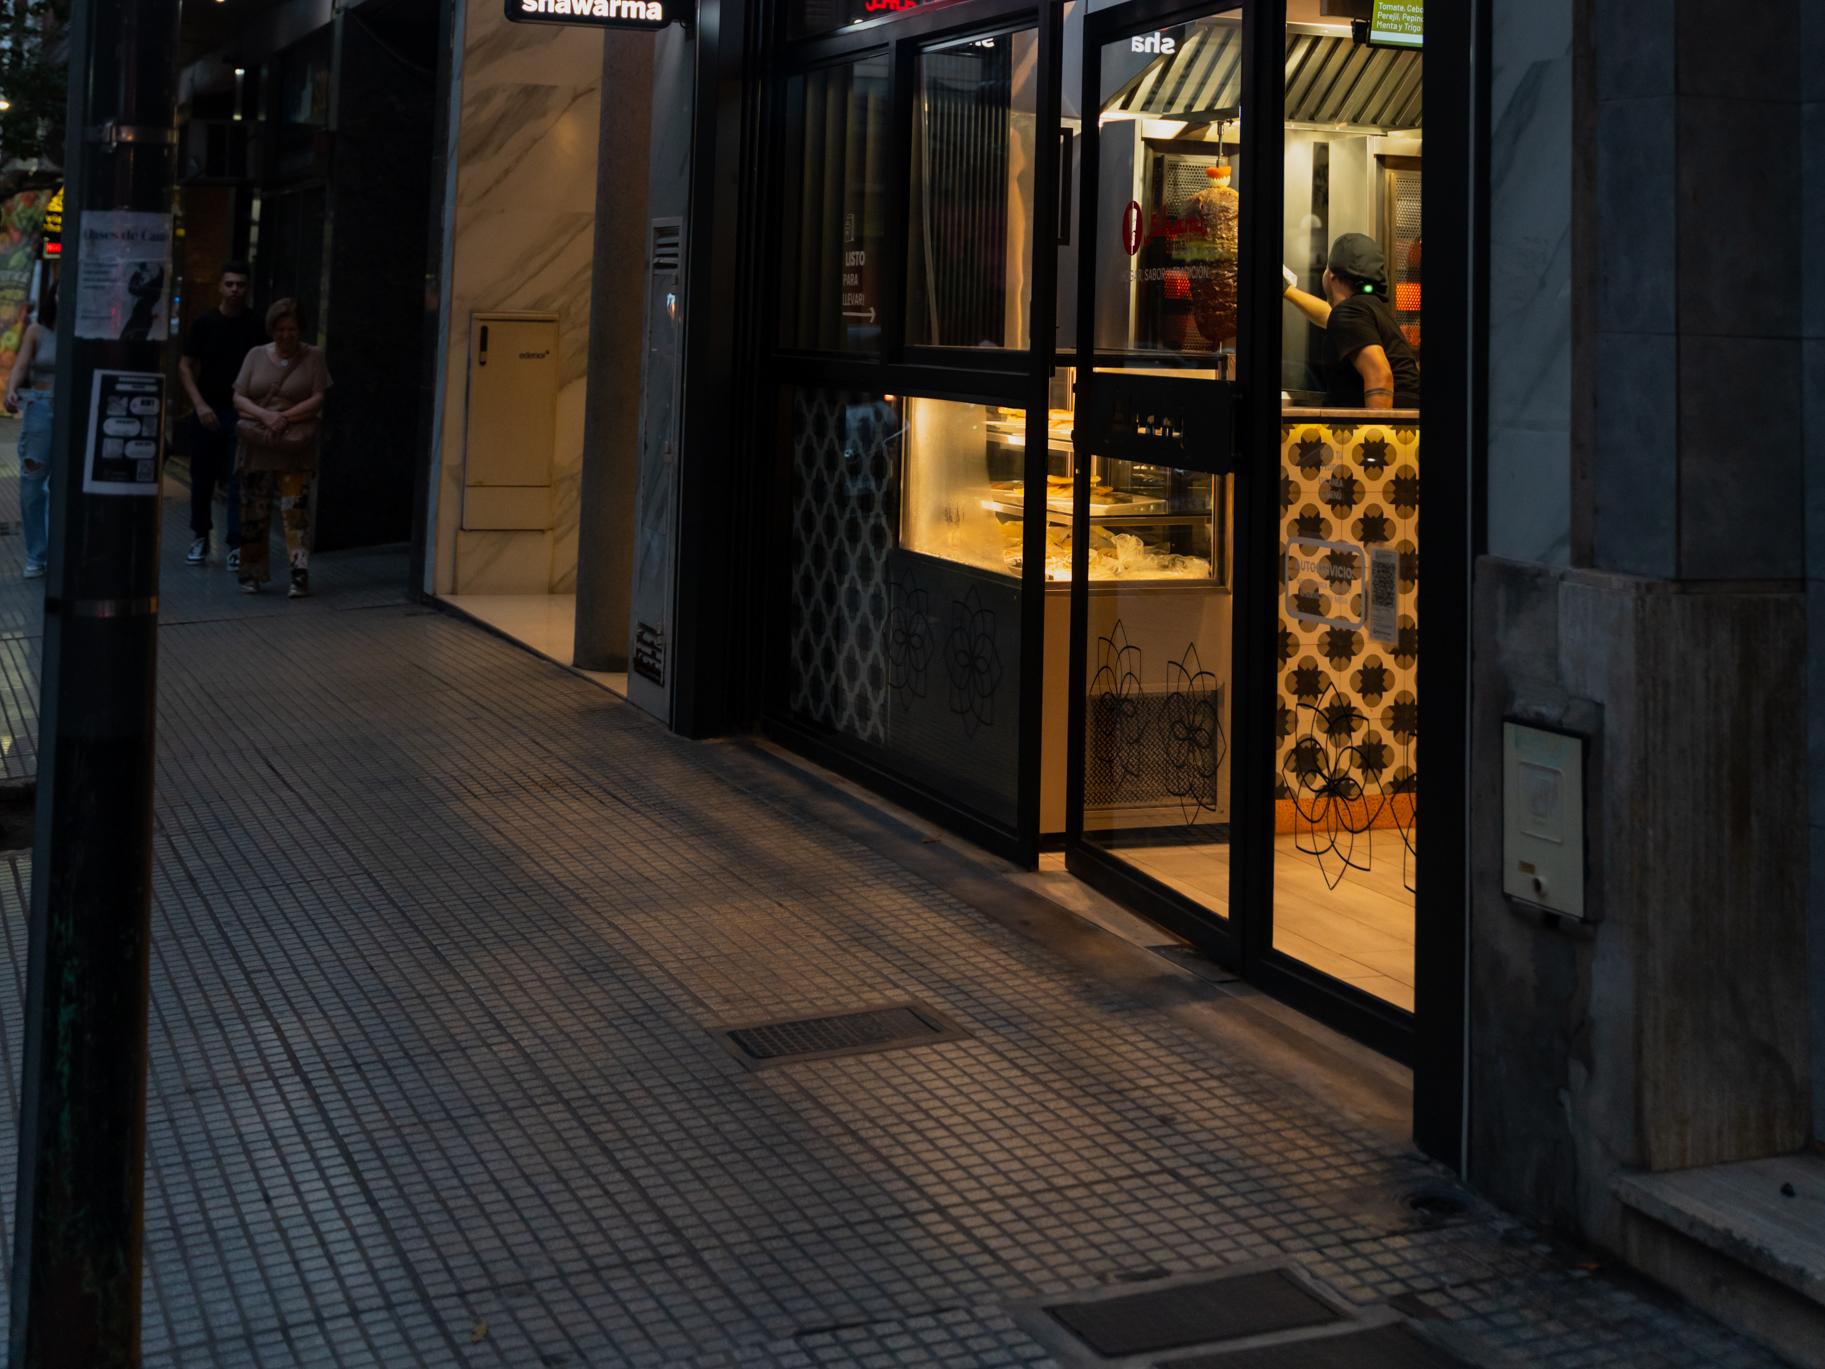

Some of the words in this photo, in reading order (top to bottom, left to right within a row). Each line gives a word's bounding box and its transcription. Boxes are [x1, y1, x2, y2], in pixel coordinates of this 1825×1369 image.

[1378, 2, 1406, 12] Tomate,
[1377, 11, 1401, 21] Perejil,
[1376, 20, 1398, 30] Menta
[1398, 24, 1403, 32] y
[1404, 22, 1422, 33] Trigo
[845, 250, 866, 267] LISTO
[842, 273, 859, 286] PARA
[1144, 267, 1166, 281] SABOR
[842, 292, 865, 306] LLEVAR!
